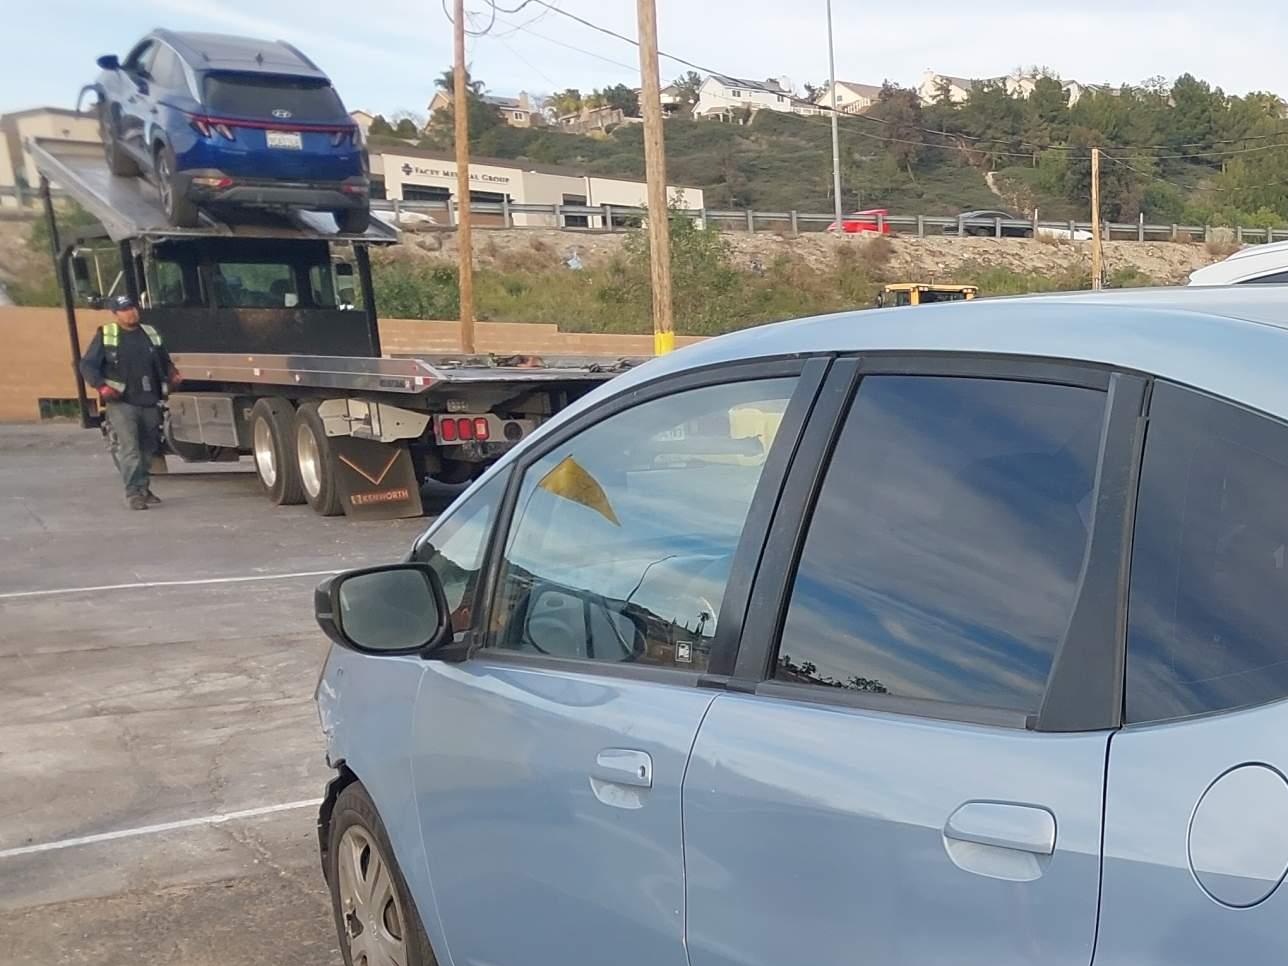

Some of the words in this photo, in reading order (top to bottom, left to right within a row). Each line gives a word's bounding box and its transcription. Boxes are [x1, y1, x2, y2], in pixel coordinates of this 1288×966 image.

[415, 166, 440, 176] FACEY
[442, 169, 480, 181] MEAL
[481, 174, 510, 184] GROUP
[363, 489, 409, 502] KENWORTH
